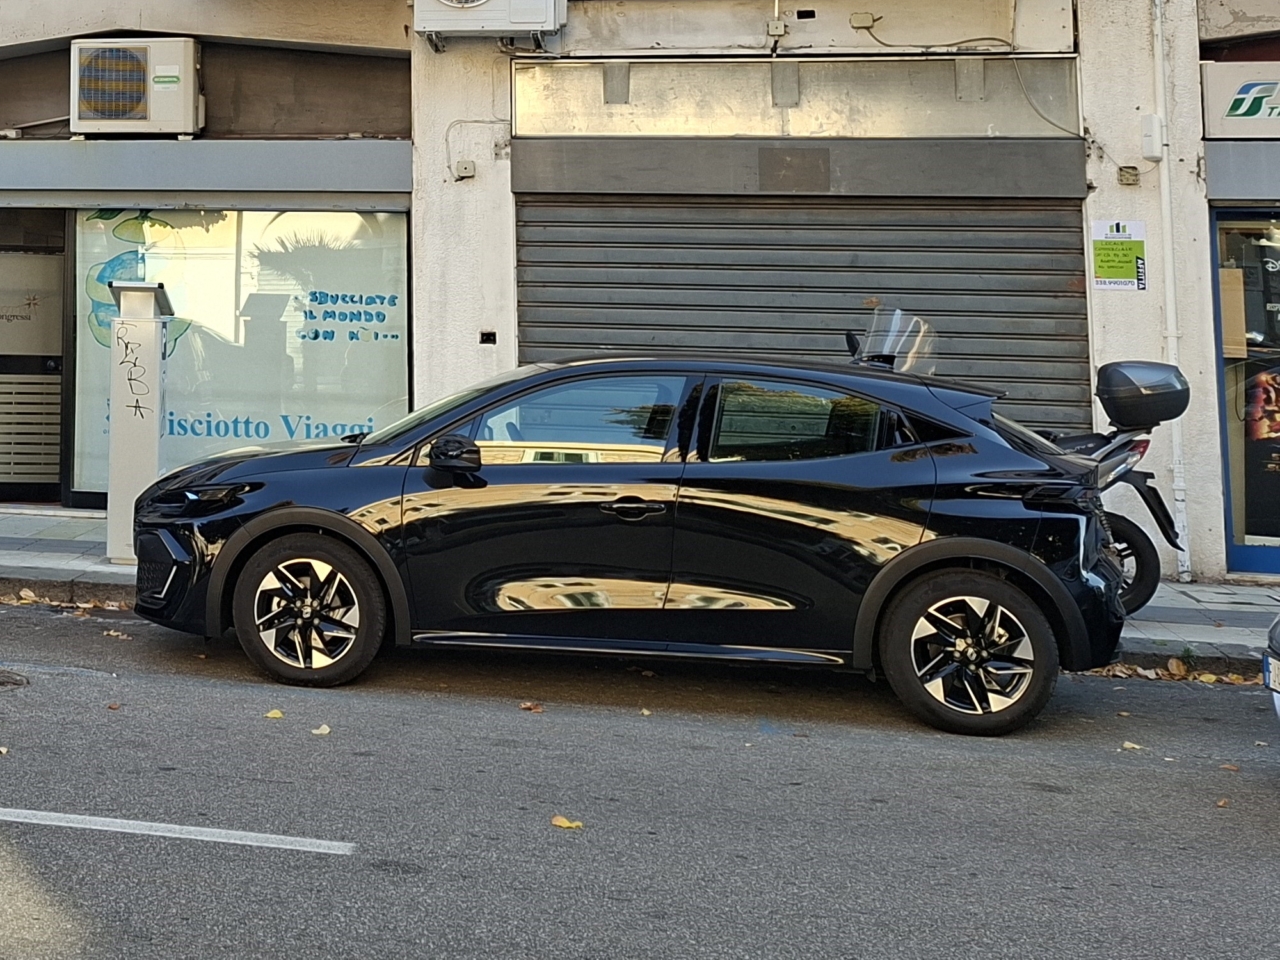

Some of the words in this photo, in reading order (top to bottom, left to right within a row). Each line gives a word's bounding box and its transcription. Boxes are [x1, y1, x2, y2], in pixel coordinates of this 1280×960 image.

[308, 290, 399, 307] SBUCCIATE
[303, 309, 317, 321] IL
[322, 309, 387, 323] MONDO
[167, 411, 270, 439] isciotto
